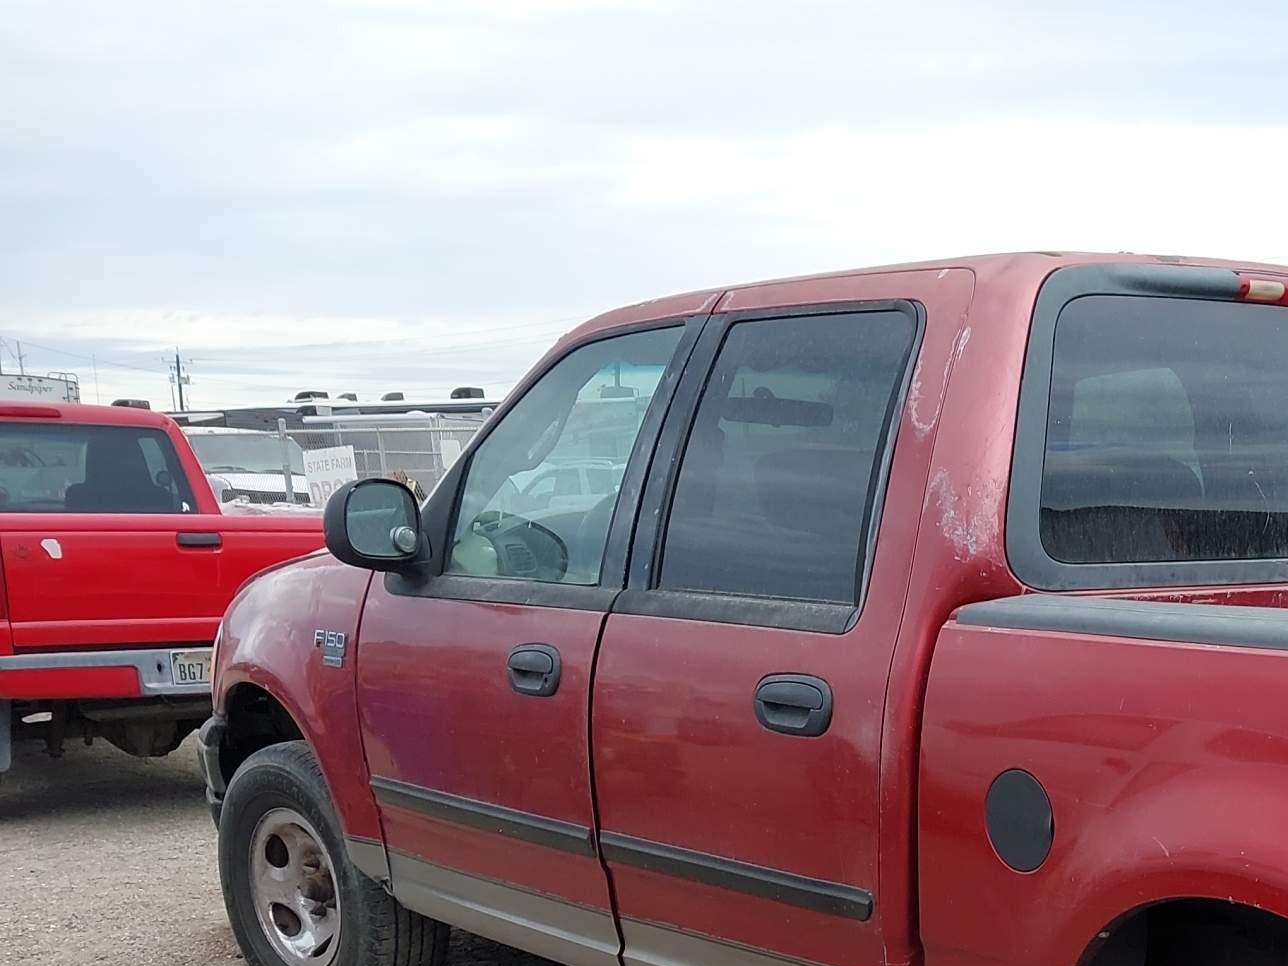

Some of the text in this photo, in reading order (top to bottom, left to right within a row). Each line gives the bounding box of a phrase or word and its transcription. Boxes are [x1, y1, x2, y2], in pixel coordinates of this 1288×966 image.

[307, 456, 352, 473] STATE FARM
[314, 629, 345, 648] F150
